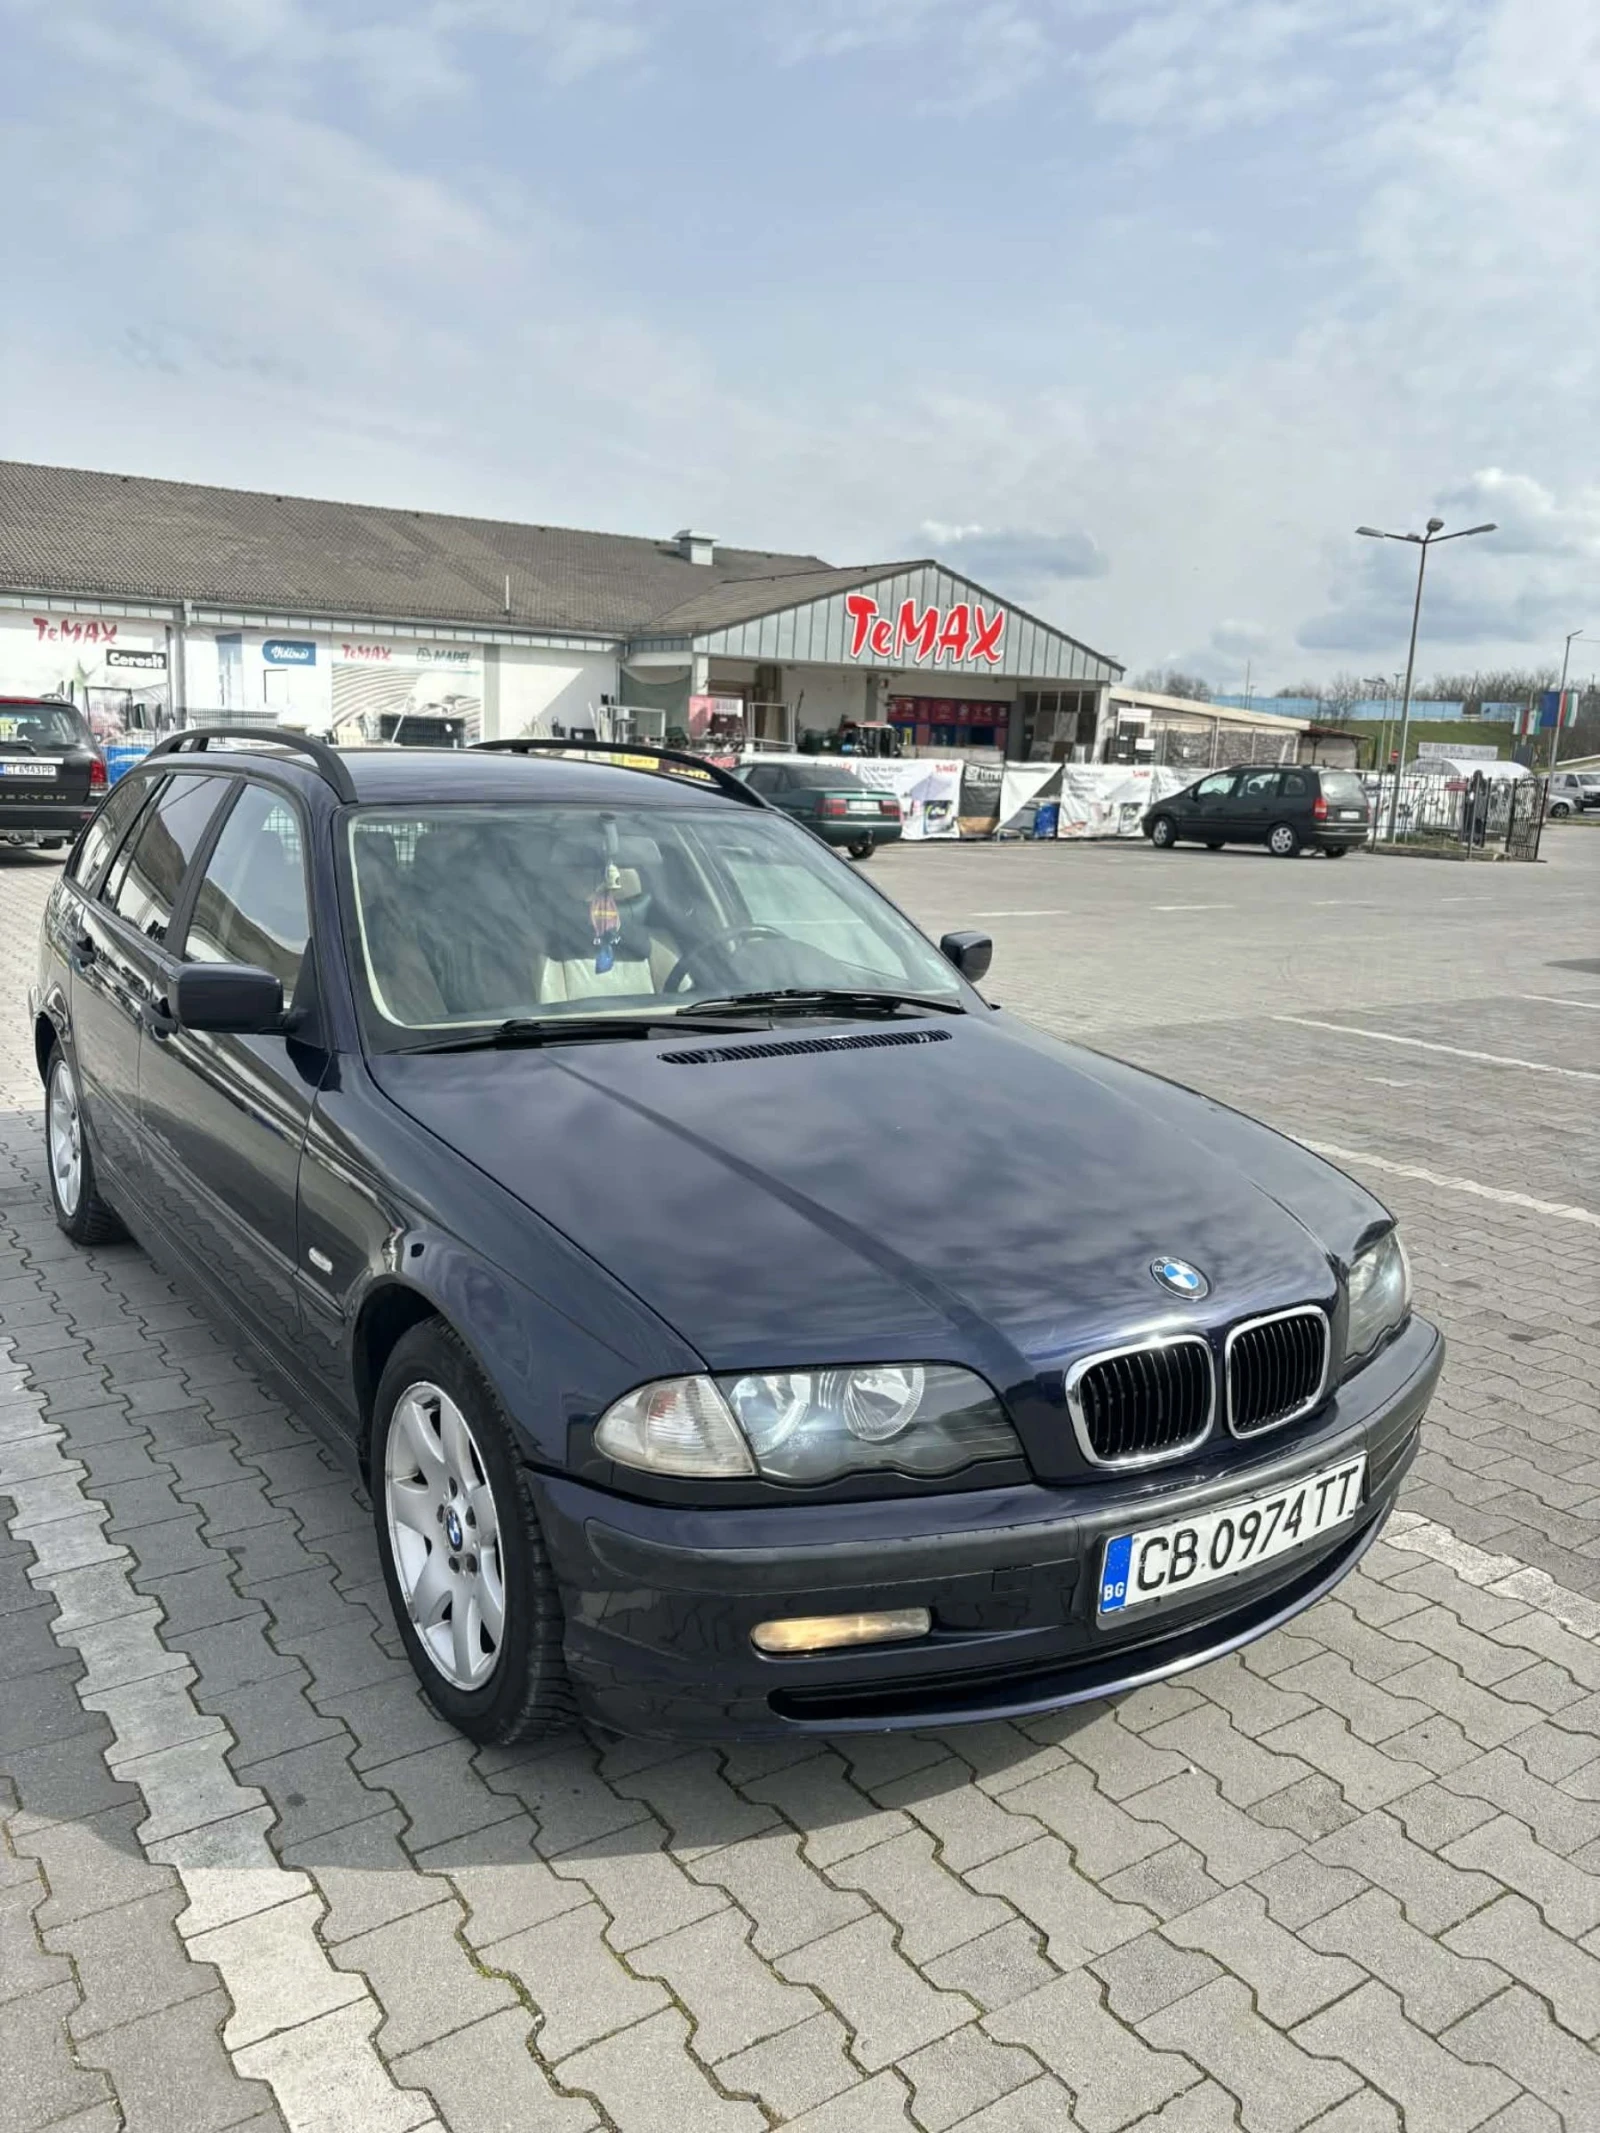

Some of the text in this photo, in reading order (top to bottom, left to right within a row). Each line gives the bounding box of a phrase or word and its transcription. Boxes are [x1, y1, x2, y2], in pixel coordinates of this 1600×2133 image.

[33, 617, 118, 645] TeMAX
[846, 594, 1006, 665] TeMAX
[109, 652, 165, 669] Ceresit
[341, 643, 392, 662] TeMAX
[0, 793, 67, 801] EXTON
[1315, 1464, 1359, 1528] TT
[1103, 1582, 1125, 1601] BG
